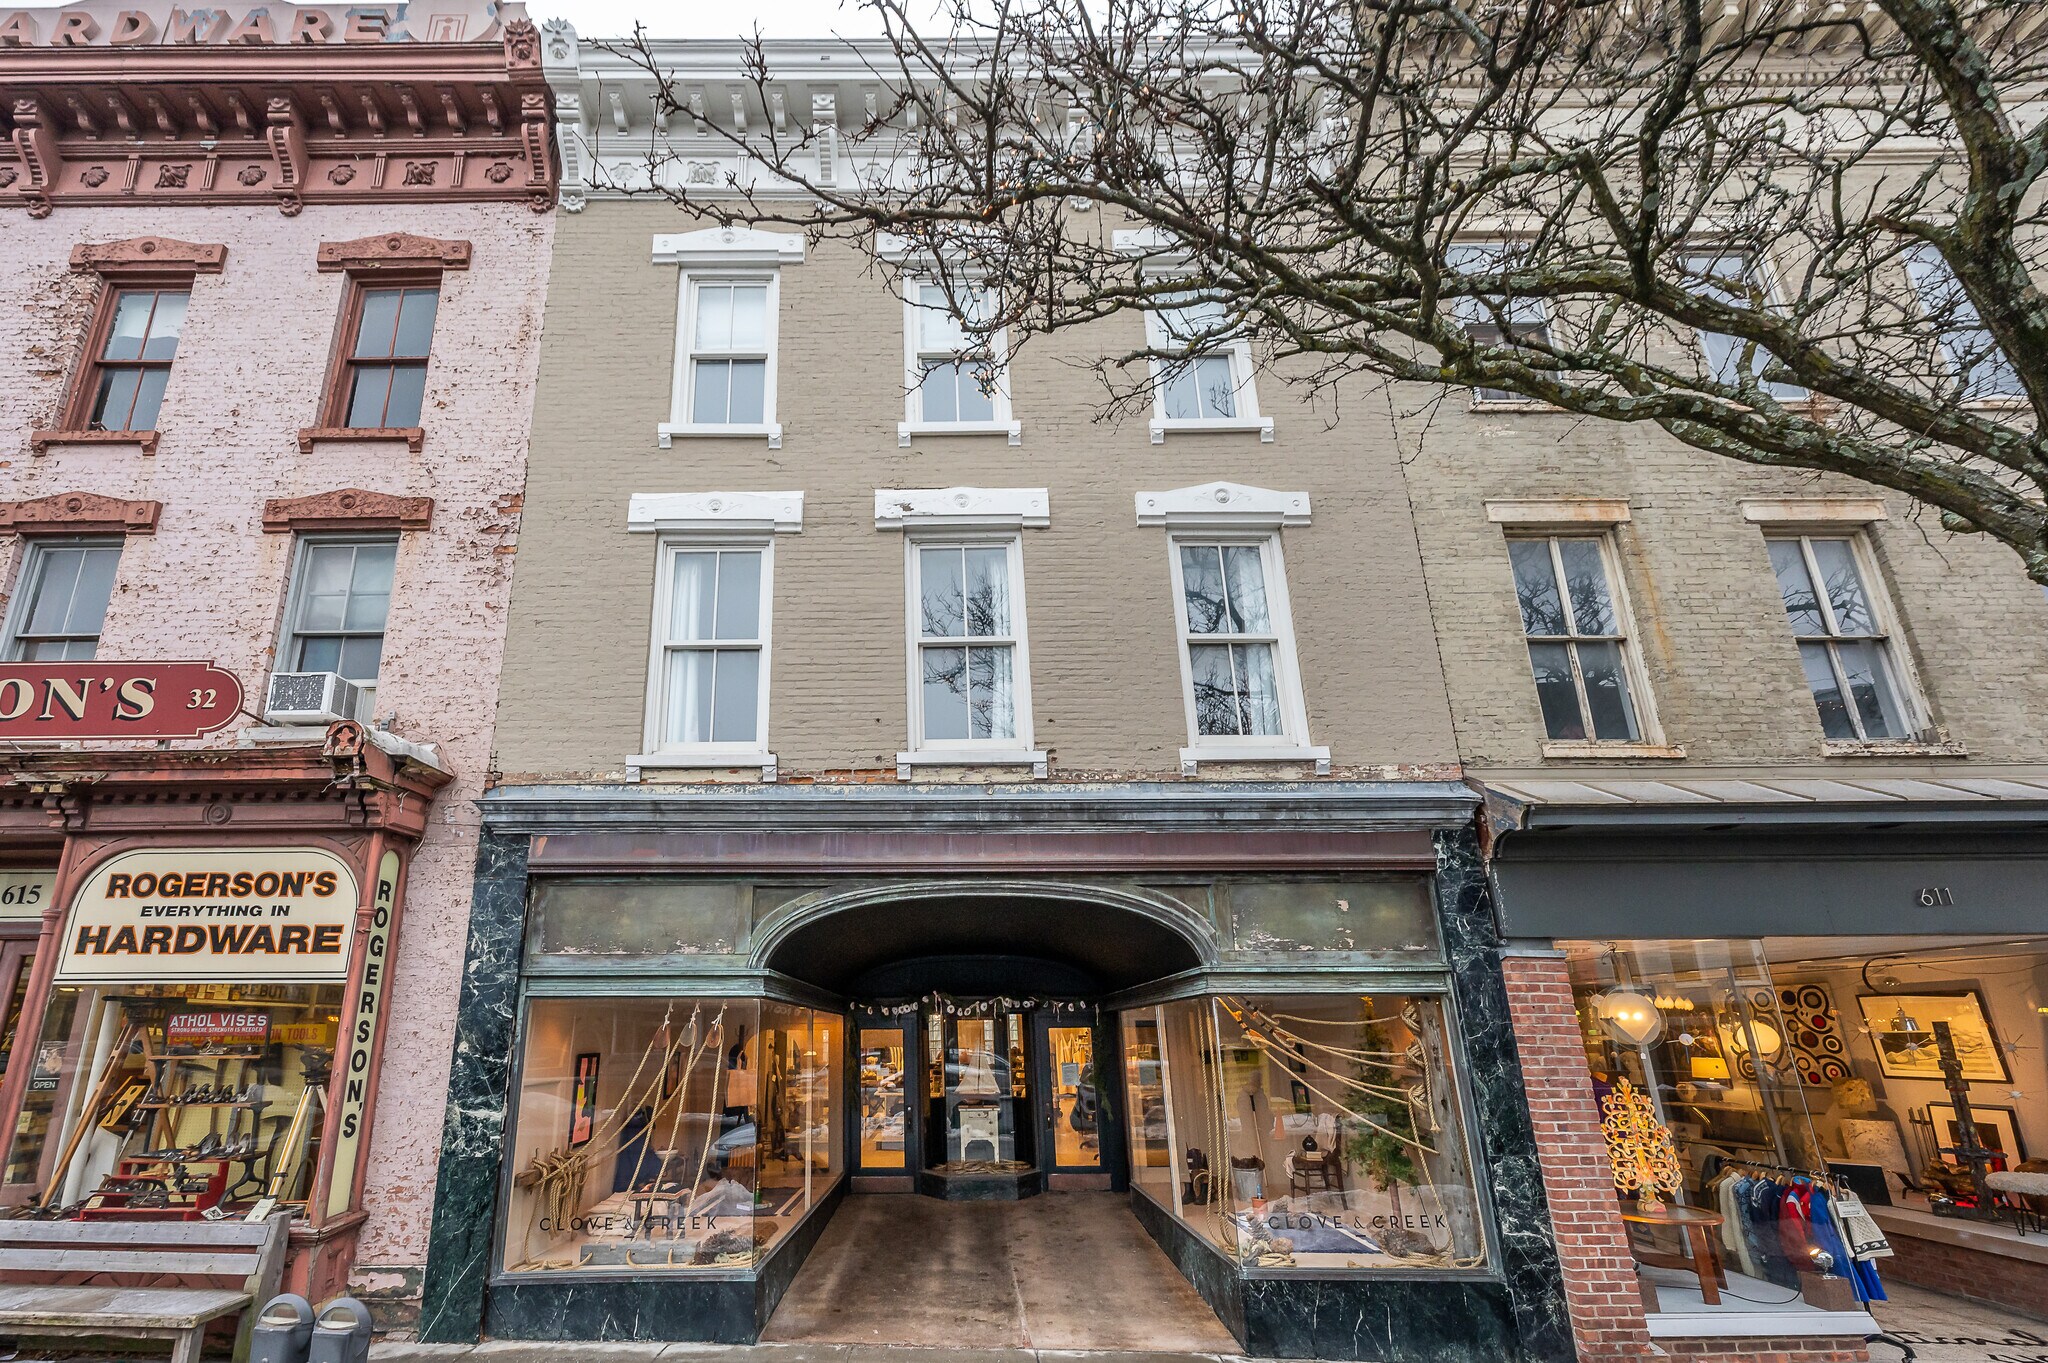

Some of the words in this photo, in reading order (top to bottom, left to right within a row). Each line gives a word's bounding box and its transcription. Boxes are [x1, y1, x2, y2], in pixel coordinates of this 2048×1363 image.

[186, 688, 217, 709] 32
[105, 871, 338, 899] ROGERSON'S
[1, 884, 43, 905] 615
[1921, 887, 1954, 906] 611
[140, 905, 262, 917] EVERYTHING
[270, 905, 290, 917] IN
[74, 924, 345, 955] HARDWARE
[342, 879, 392, 1139] ROGERSON'S
[170, 1014, 216, 1027] ATHOL
[220, 1014, 267, 1027] VISES
[288, 1028, 318, 1040] TOOLS
[33, 1081, 56, 1089] OPEN
[539, 1217, 614, 1231] CLOVE
[624, 1217, 635, 1231] &
[643, 1216, 717, 1231] CREEK
[1268, 1215, 1343, 1230] CLOVE
[1353, 1215, 1366, 1229] &
[1372, 1214, 1447, 1229] CREEK
